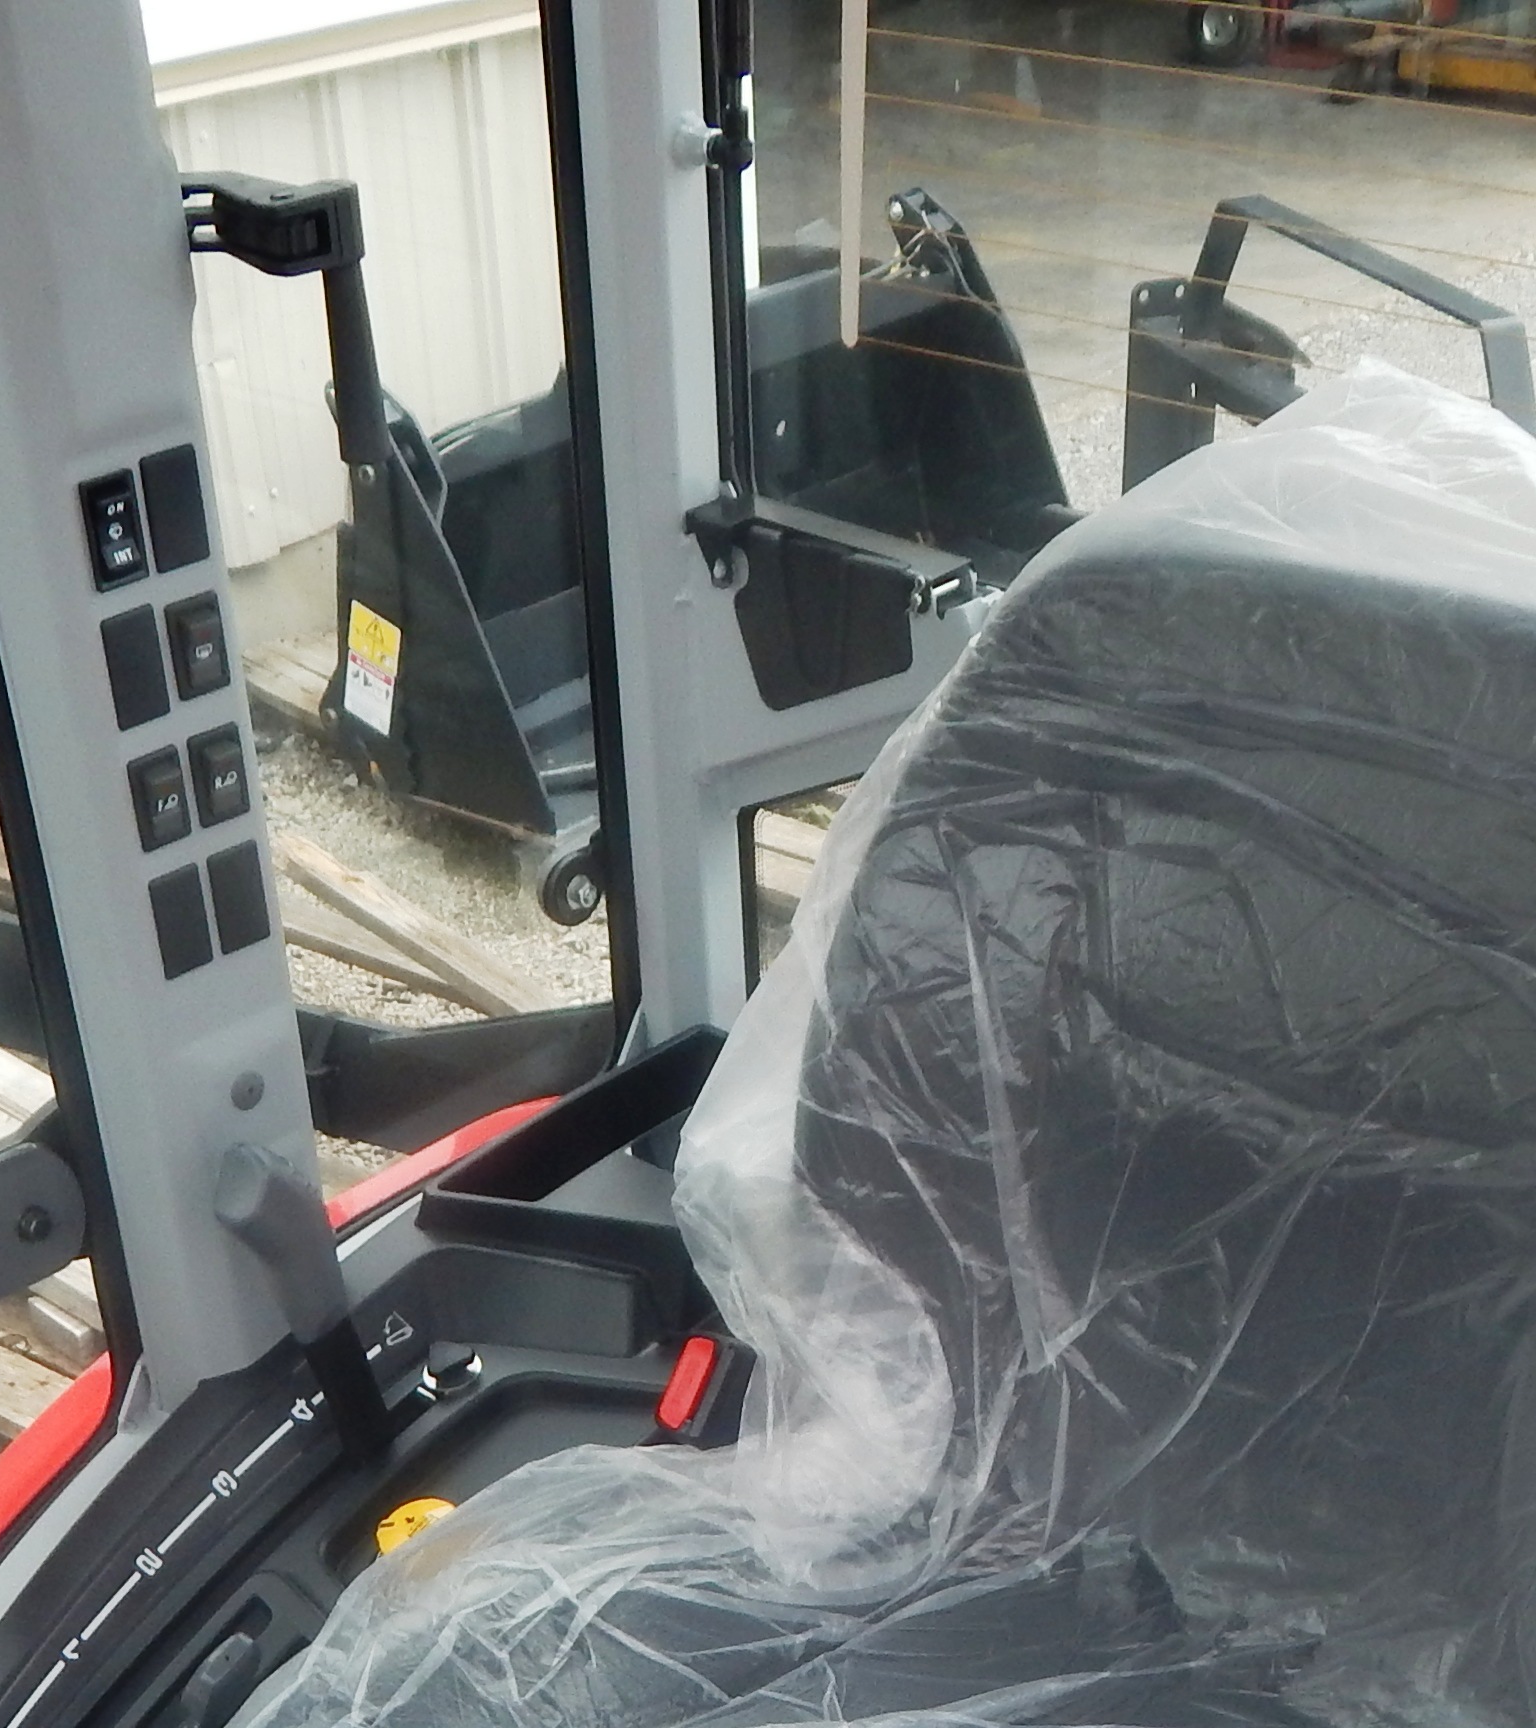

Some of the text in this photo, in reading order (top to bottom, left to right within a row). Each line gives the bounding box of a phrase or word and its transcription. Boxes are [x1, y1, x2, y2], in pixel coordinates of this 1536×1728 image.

[107, 502, 124, 516] ON
[114, 547, 133, 566] INT
[290, 1398, 314, 1421] 4
[212, 1470, 238, 1497] 3
[135, 1547, 163, 1577] 2
[63, 1637, 80, 1660] 1
